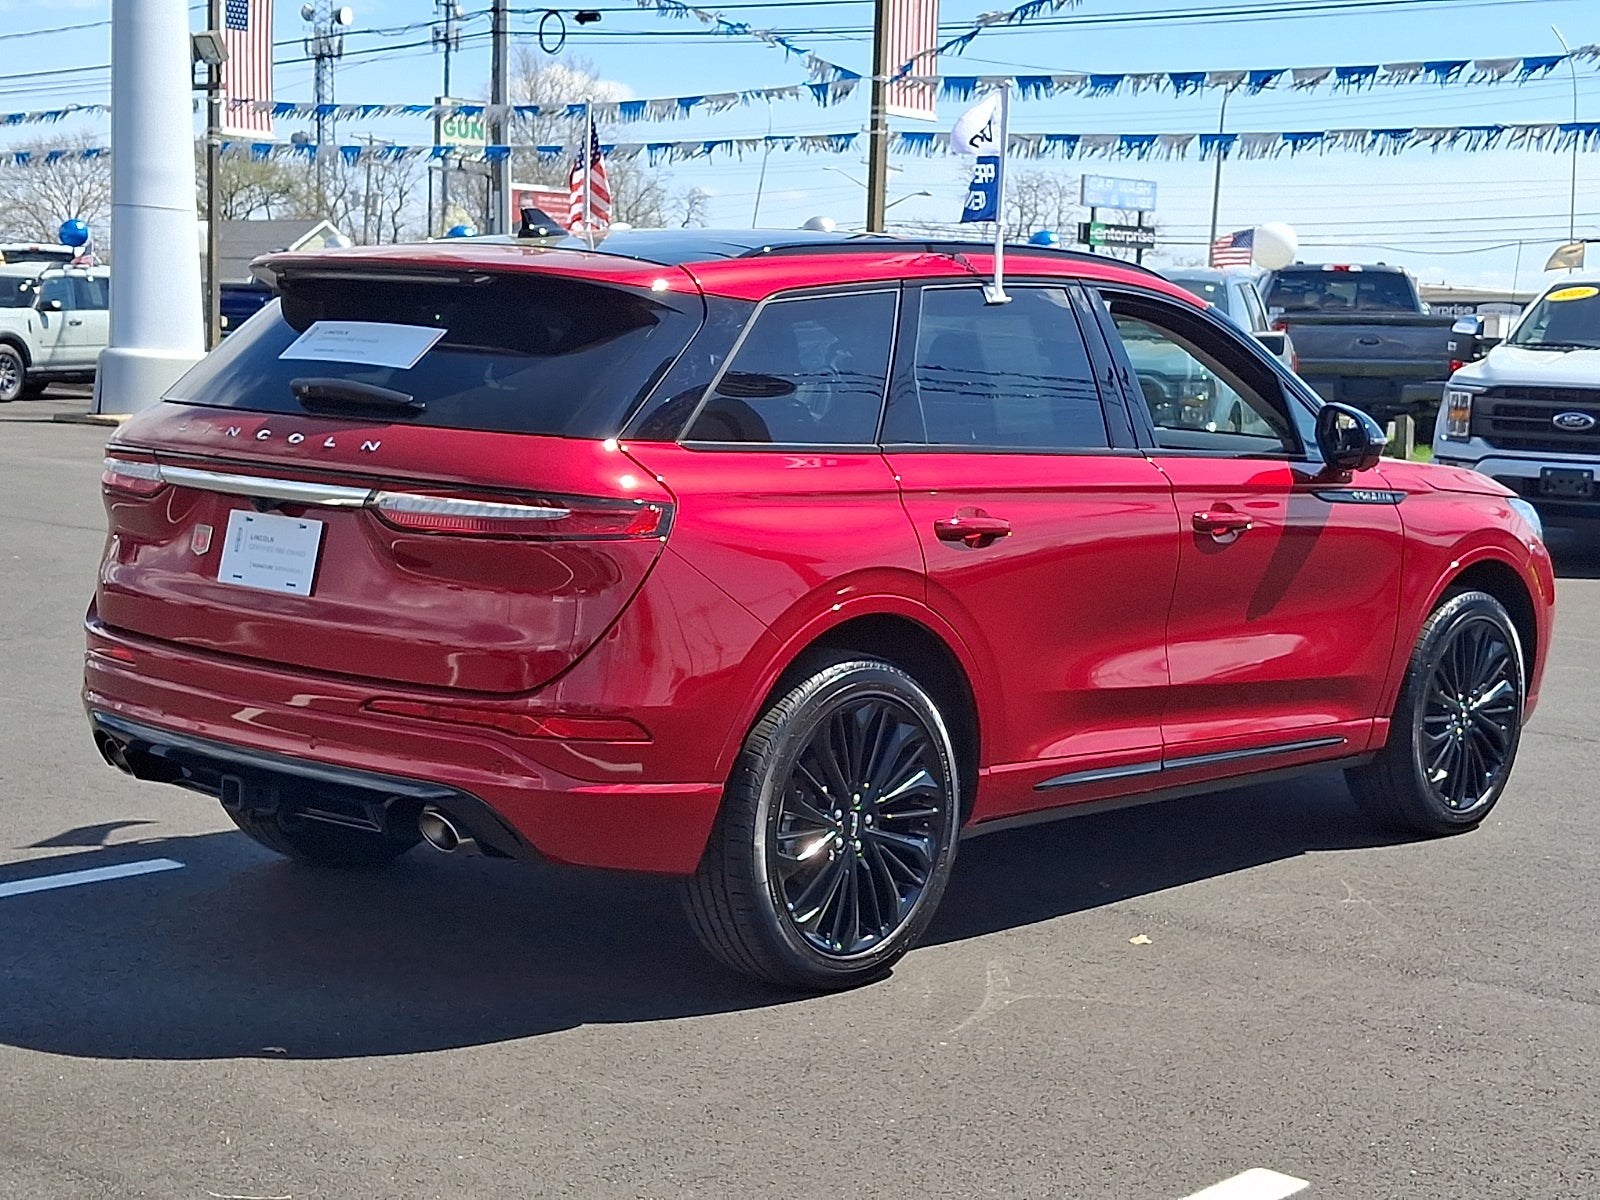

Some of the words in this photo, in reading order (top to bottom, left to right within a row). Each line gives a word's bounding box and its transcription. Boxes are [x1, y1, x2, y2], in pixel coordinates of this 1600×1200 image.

[444, 119, 484, 140] GUN
[1089, 177, 1113, 191] CAR
[1119, 180, 1151, 195] WASH
[1090, 227, 1154, 245] enterprise
